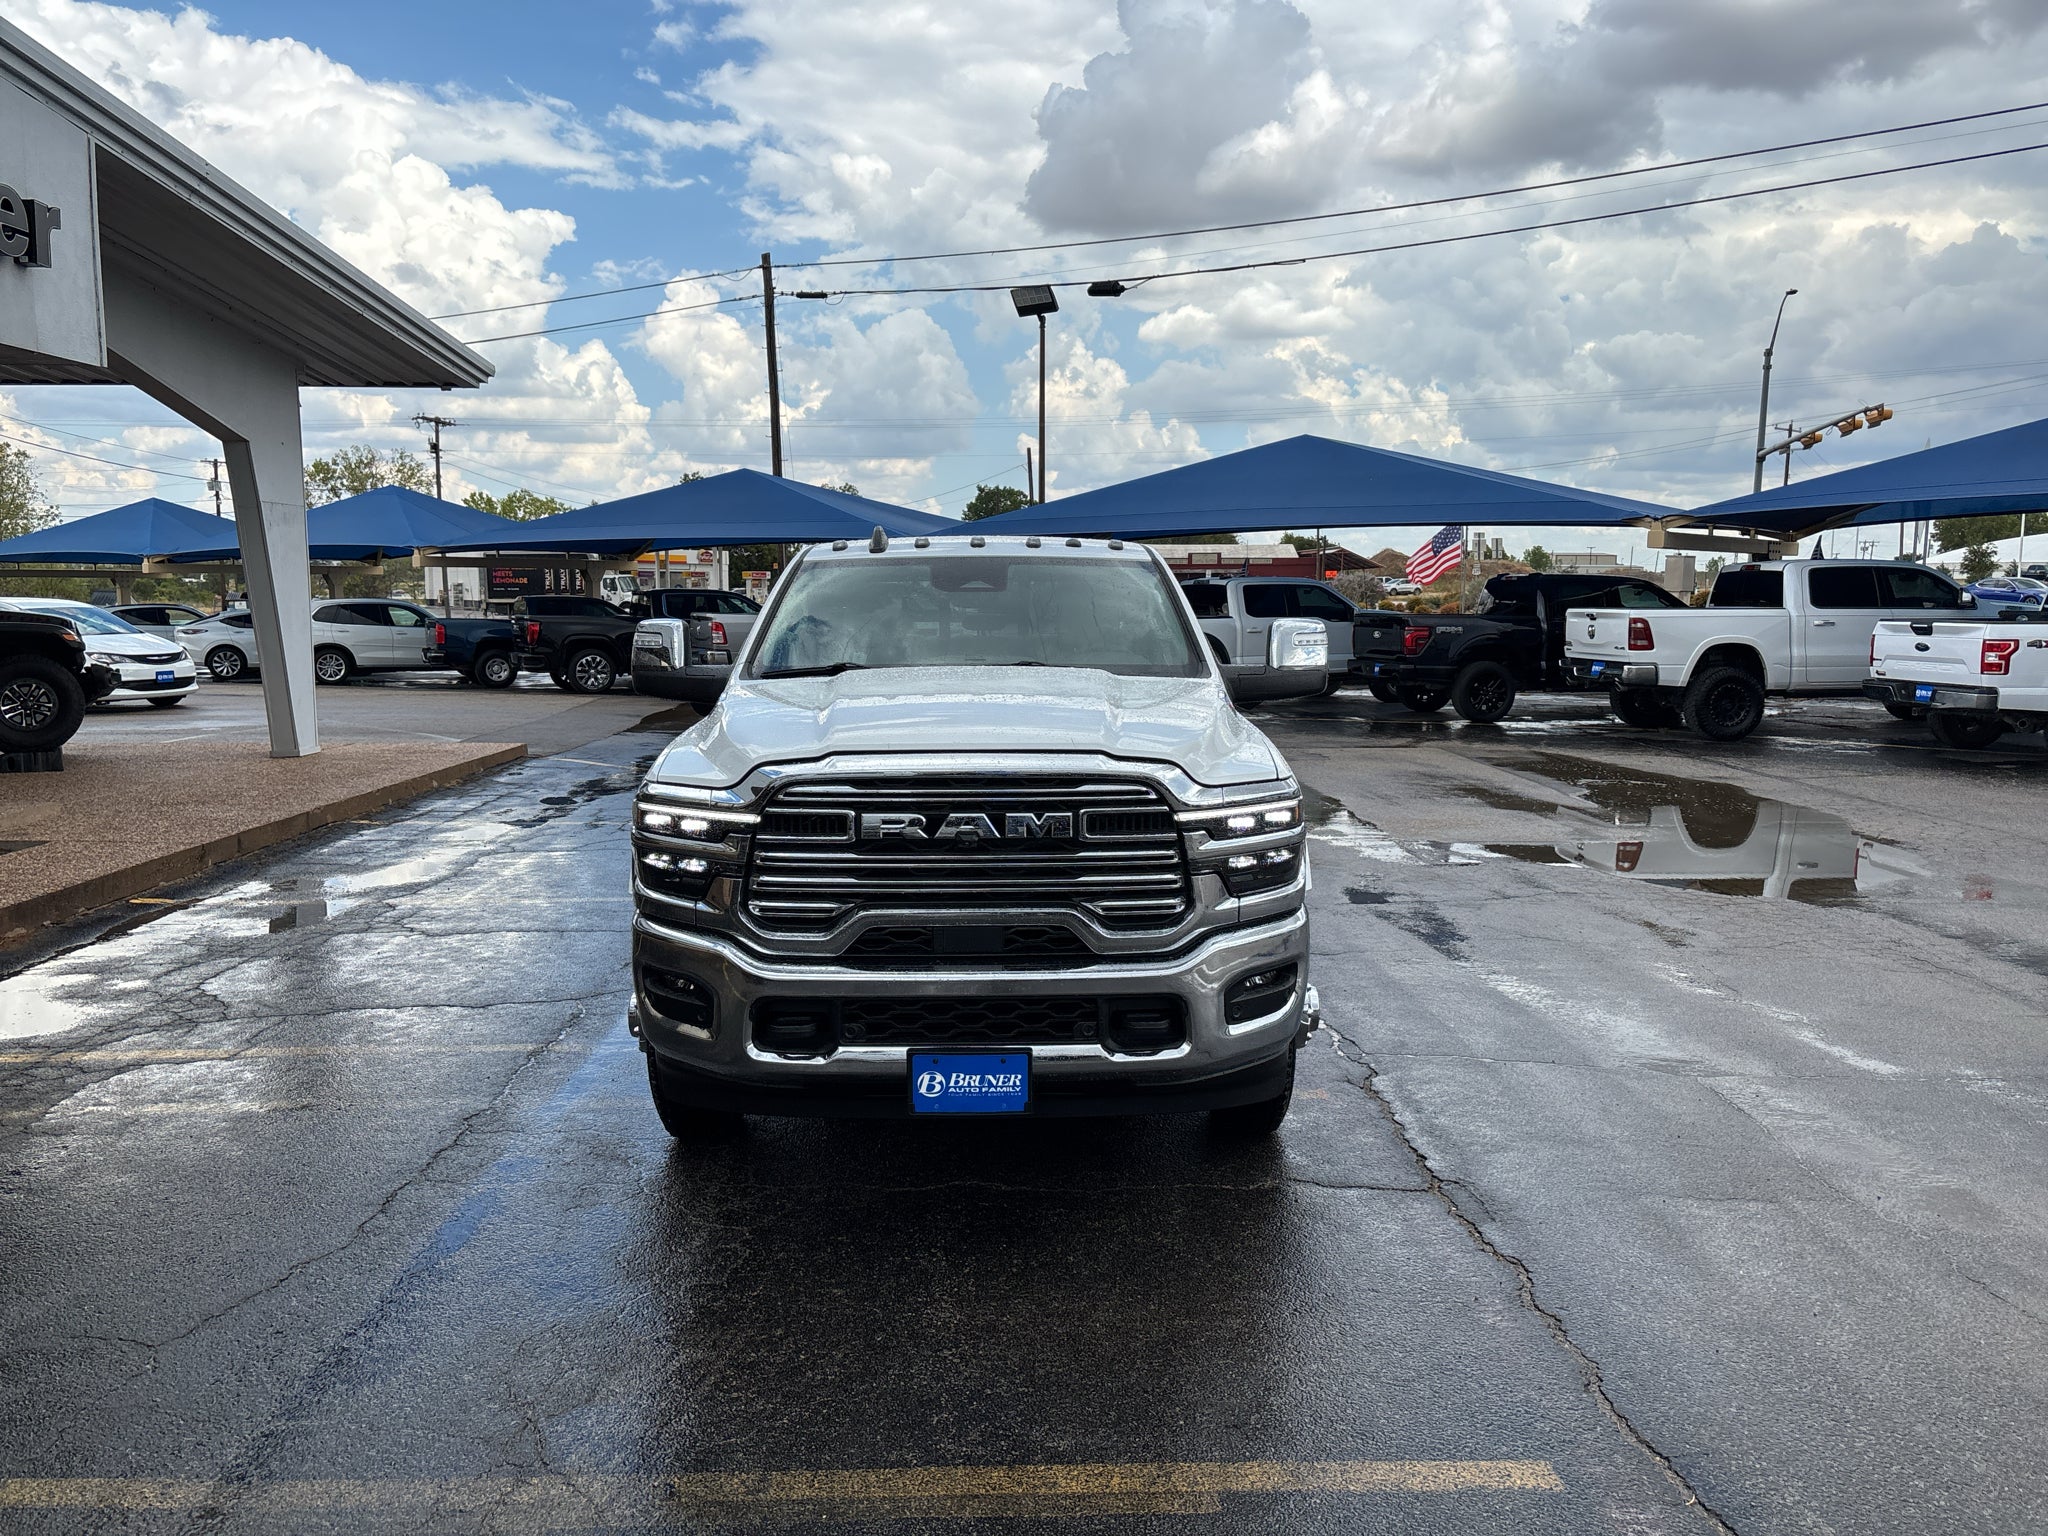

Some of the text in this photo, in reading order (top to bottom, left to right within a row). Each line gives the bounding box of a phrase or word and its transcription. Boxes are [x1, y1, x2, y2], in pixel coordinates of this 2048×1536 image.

[544, 568, 552, 590] TRULY
[861, 813, 1073, 839] RAM
[948, 1072, 1022, 1087] BRUNER
